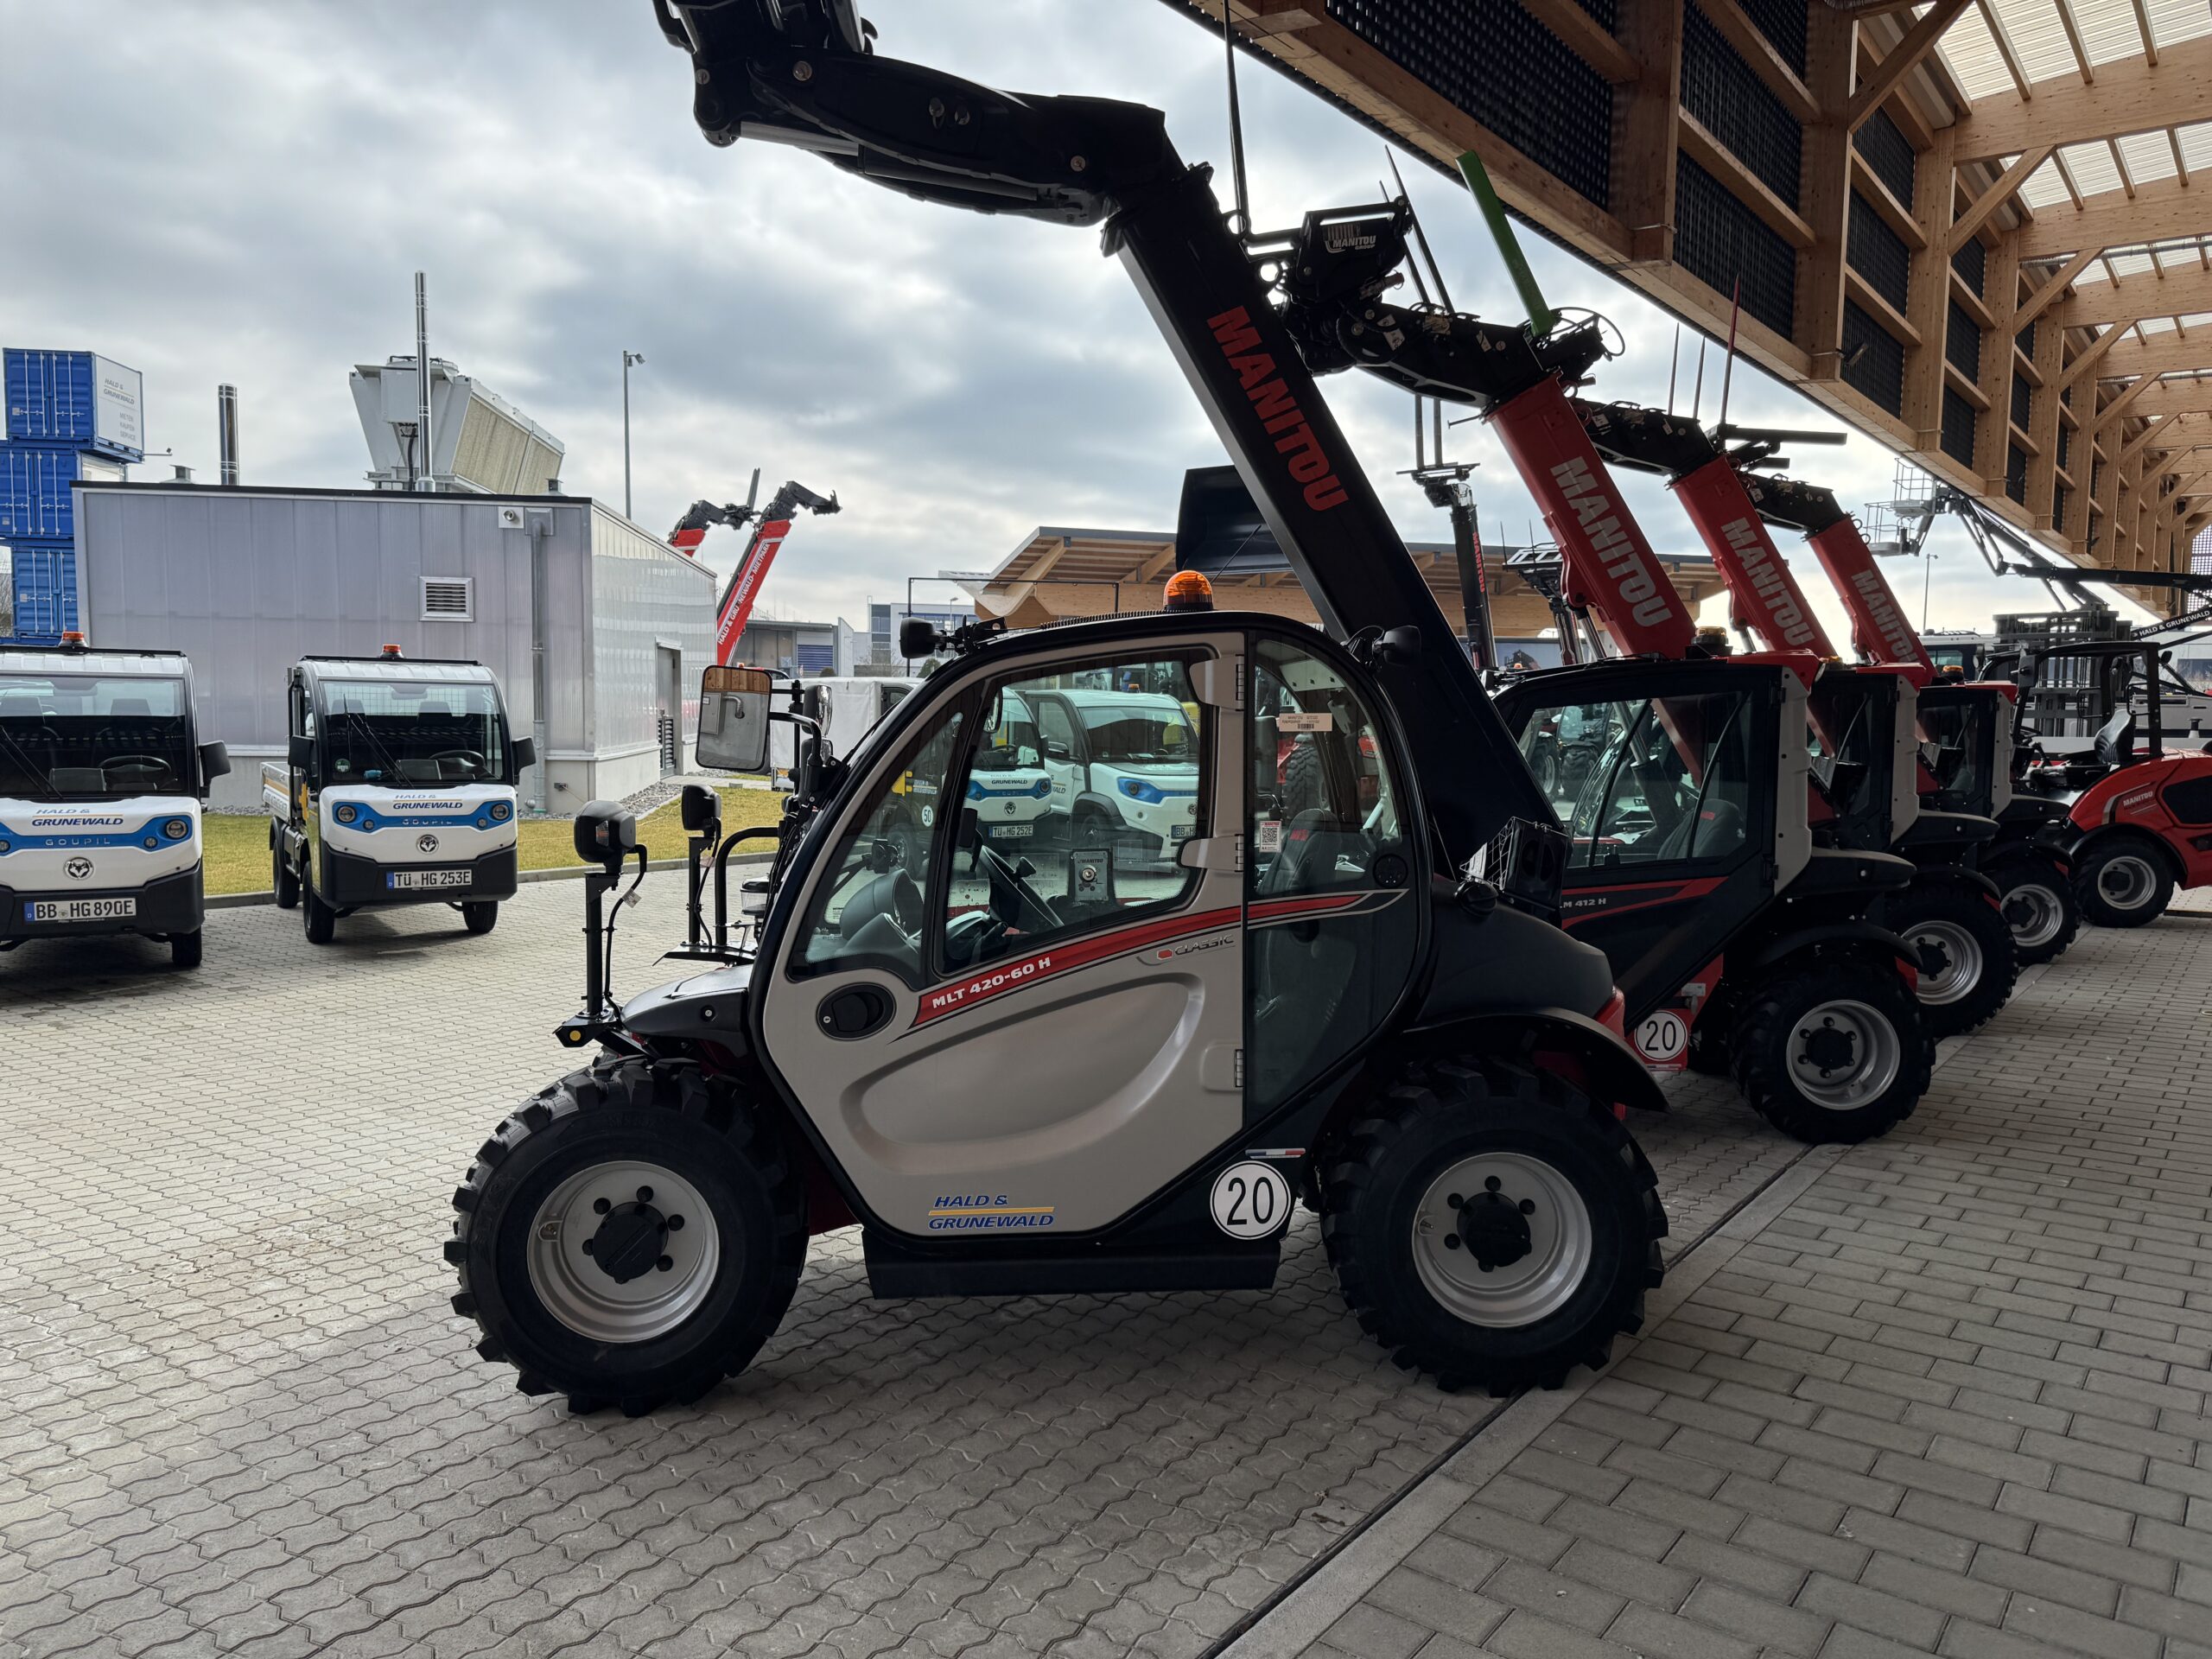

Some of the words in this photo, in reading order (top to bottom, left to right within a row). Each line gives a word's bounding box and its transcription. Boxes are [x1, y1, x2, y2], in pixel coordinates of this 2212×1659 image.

[1333, 235, 1376, 248] MANITOU
[105, 378, 118, 388] HALD
[104, 389, 135, 404] GRUNEWALD
[1207, 305, 1350, 512] MANITOU
[1549, 456, 1673, 627] MANITOU
[1472, 531, 1485, 594] MANITOU
[1720, 517, 1815, 646] MANITOU
[717, 626, 729, 645] HALD
[753, 542, 770, 575] MIETPARK
[2139, 626, 2158, 637] HALD
[2165, 610, 2210, 629] GRUNEWALD
[2122, 791, 2153, 807] MANITOU
[32, 817, 124, 827] GRUNEWALD
[924, 810, 931, 823] 50
[1007, 827, 1015, 836] HG
[1016, 825, 1033, 836] 252E
[1176, 827, 1185, 836] BB
[395, 873, 411, 887] TÜ
[421, 874, 438, 886] HG
[440, 871, 471, 885] 253E
[36, 904, 57, 918] BB
[70, 901, 92, 918] HG
[94, 899, 134, 916] 890E
[1574, 899, 1596, 907] 412
[1174, 934, 1235, 956] CLASSIC
[932, 988, 965, 1009] MLT
[969, 963, 1035, 995] 420-60
[1039, 957, 1052, 969] H
[1644, 1020, 1677, 1052] 20
[934, 1195, 990, 1207] HALD
[994, 1194, 1008, 1205] &
[1226, 1177, 1274, 1225] 20
[929, 1215, 1054, 1229] GRUNEWALD
